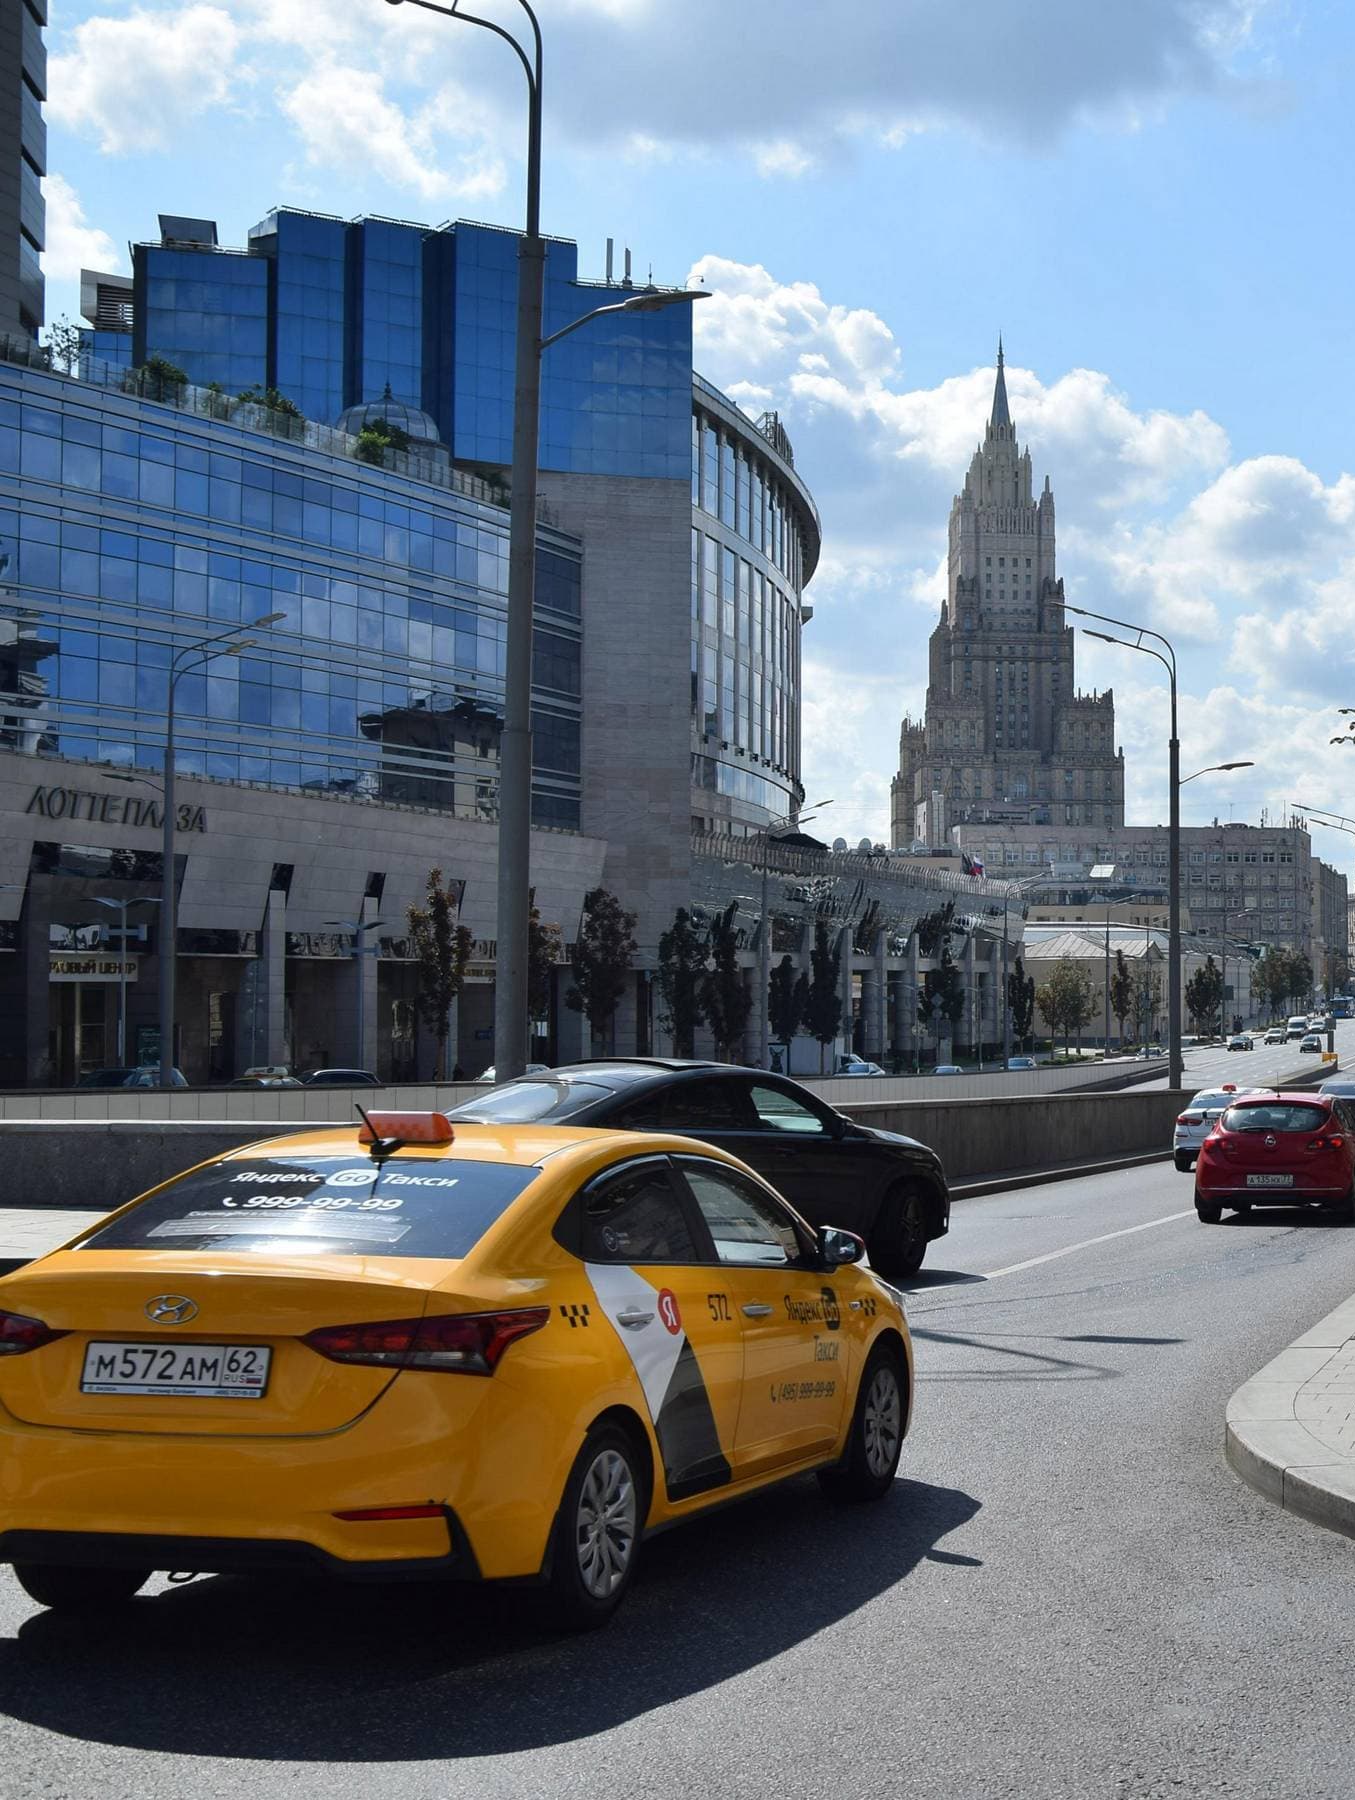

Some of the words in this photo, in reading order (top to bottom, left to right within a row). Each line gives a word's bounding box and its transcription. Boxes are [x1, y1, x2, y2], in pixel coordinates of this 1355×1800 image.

[230, 1171, 327, 1184] Яндекс
[381, 1173, 459, 1188] Такси
[242, 1195, 404, 1211] 999-99-99
[661, 1296, 678, 1327] Я
[707, 1293, 732, 1322] 572
[783, 1295, 822, 1325] Яндекс
[813, 1335, 839, 1362] Такси
[226, 1350, 258, 1374] 62
[223, 1374, 246, 1383] RUS
